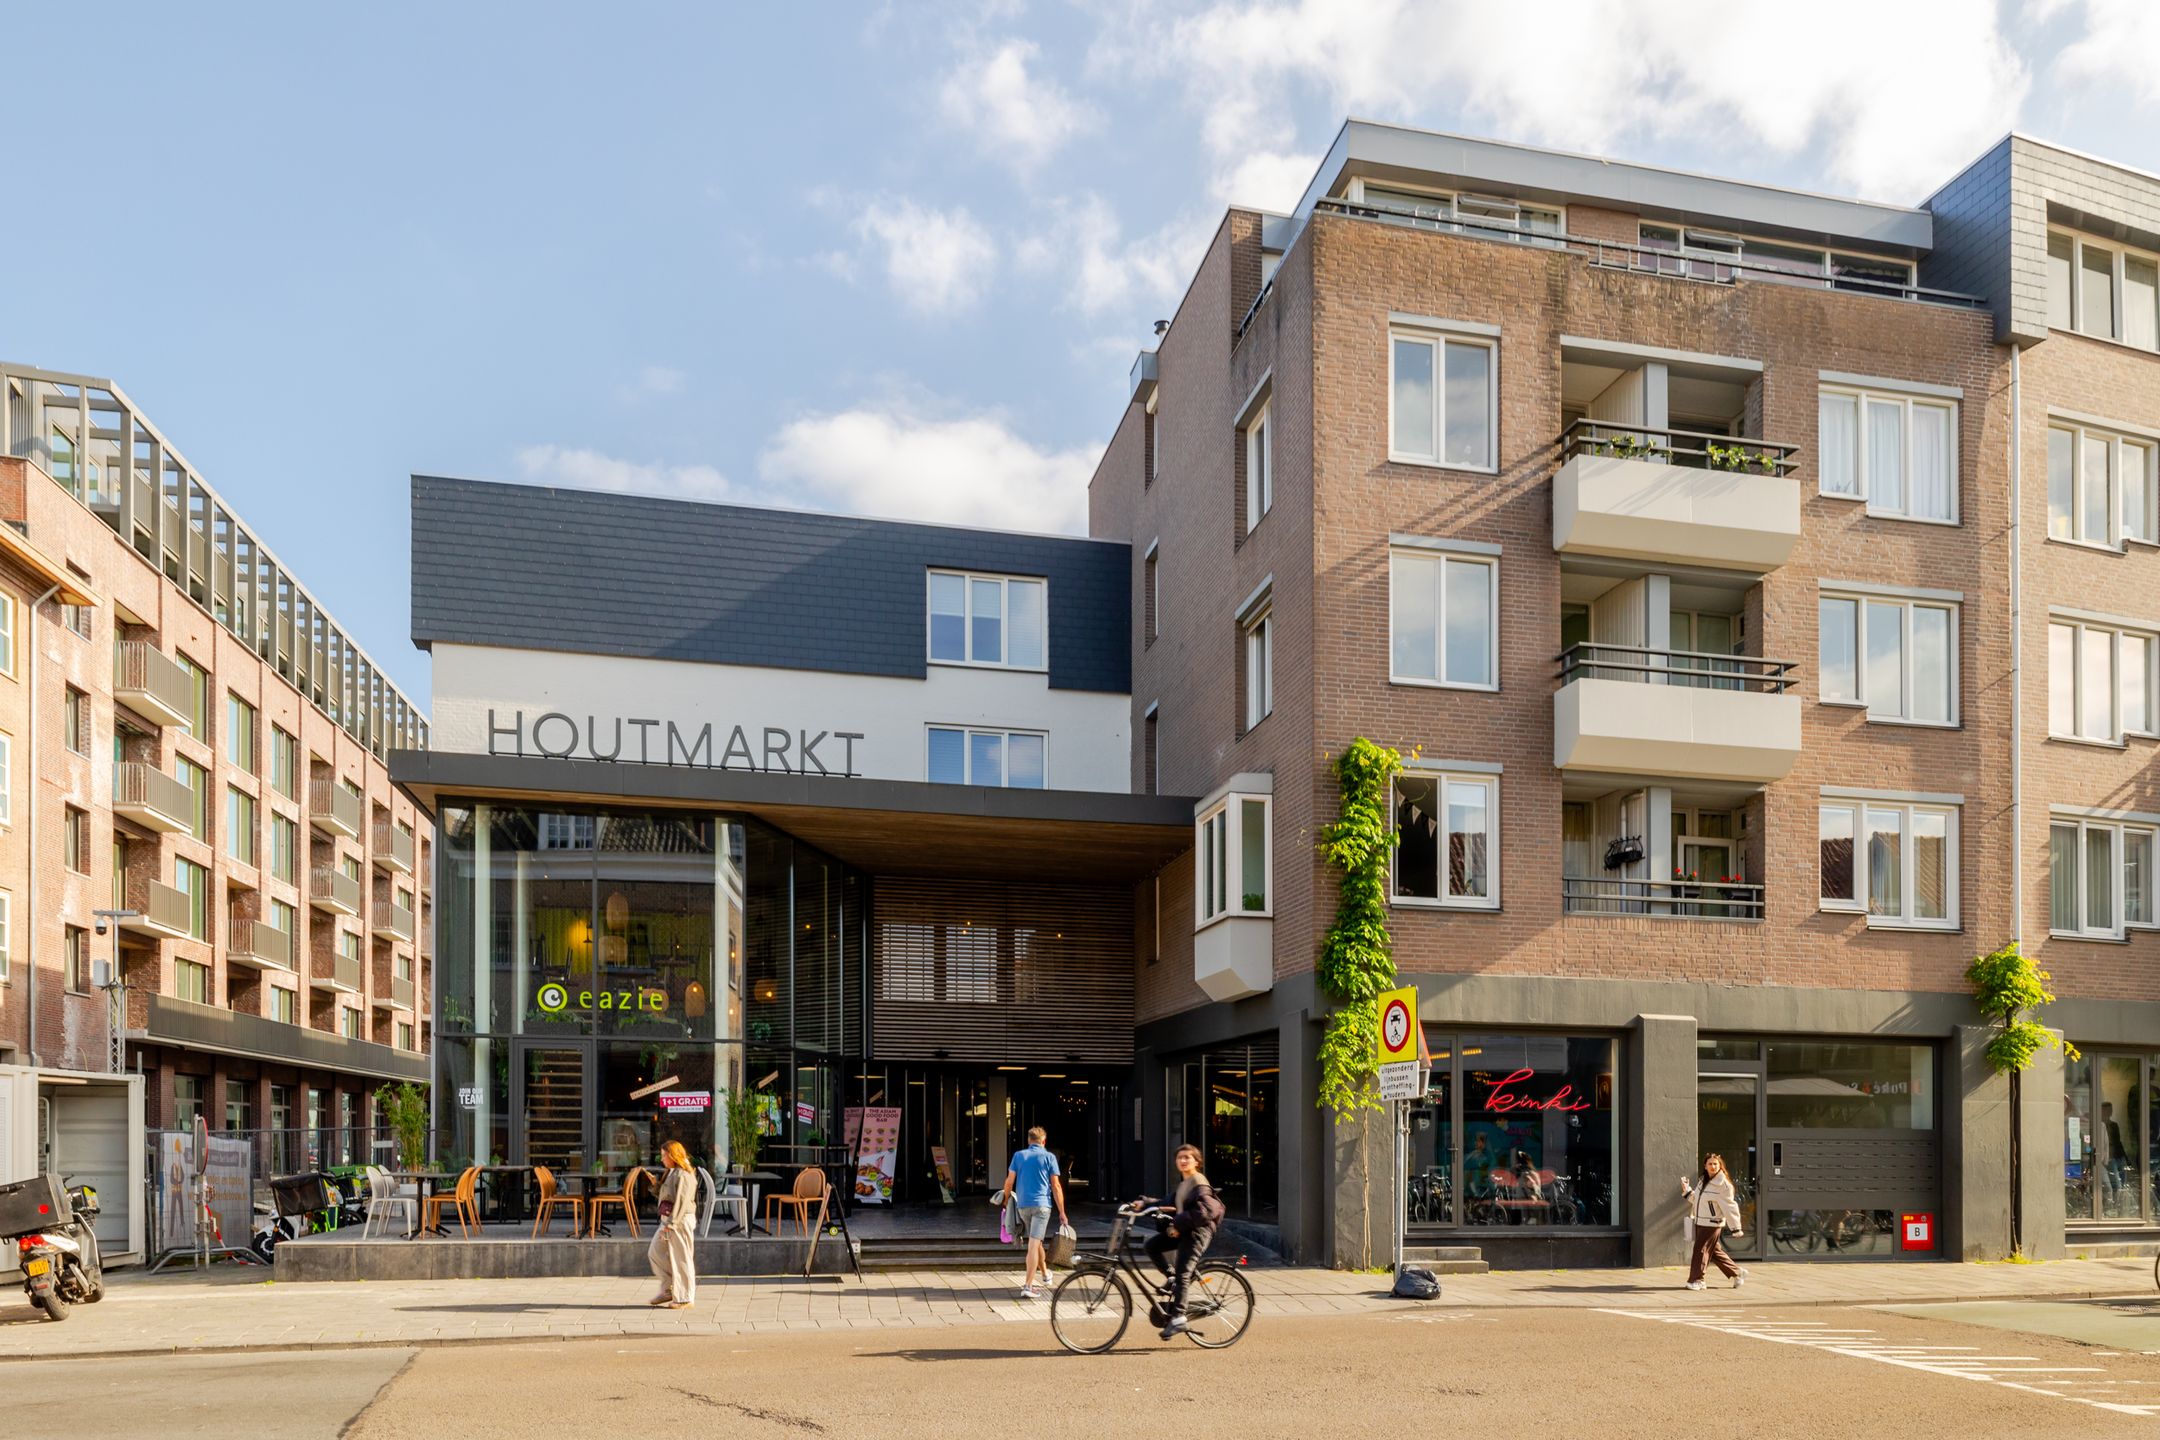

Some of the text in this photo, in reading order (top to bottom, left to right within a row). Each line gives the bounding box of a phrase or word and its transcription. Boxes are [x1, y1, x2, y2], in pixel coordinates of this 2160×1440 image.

[488, 709, 865, 776] HOUTMARKT
[580, 986, 663, 1010] eazie
[460, 1095, 484, 1104] TEAM
[662, 1097, 709, 1106] 1+1 GRATIS
[1914, 1227, 1921, 1237] B
